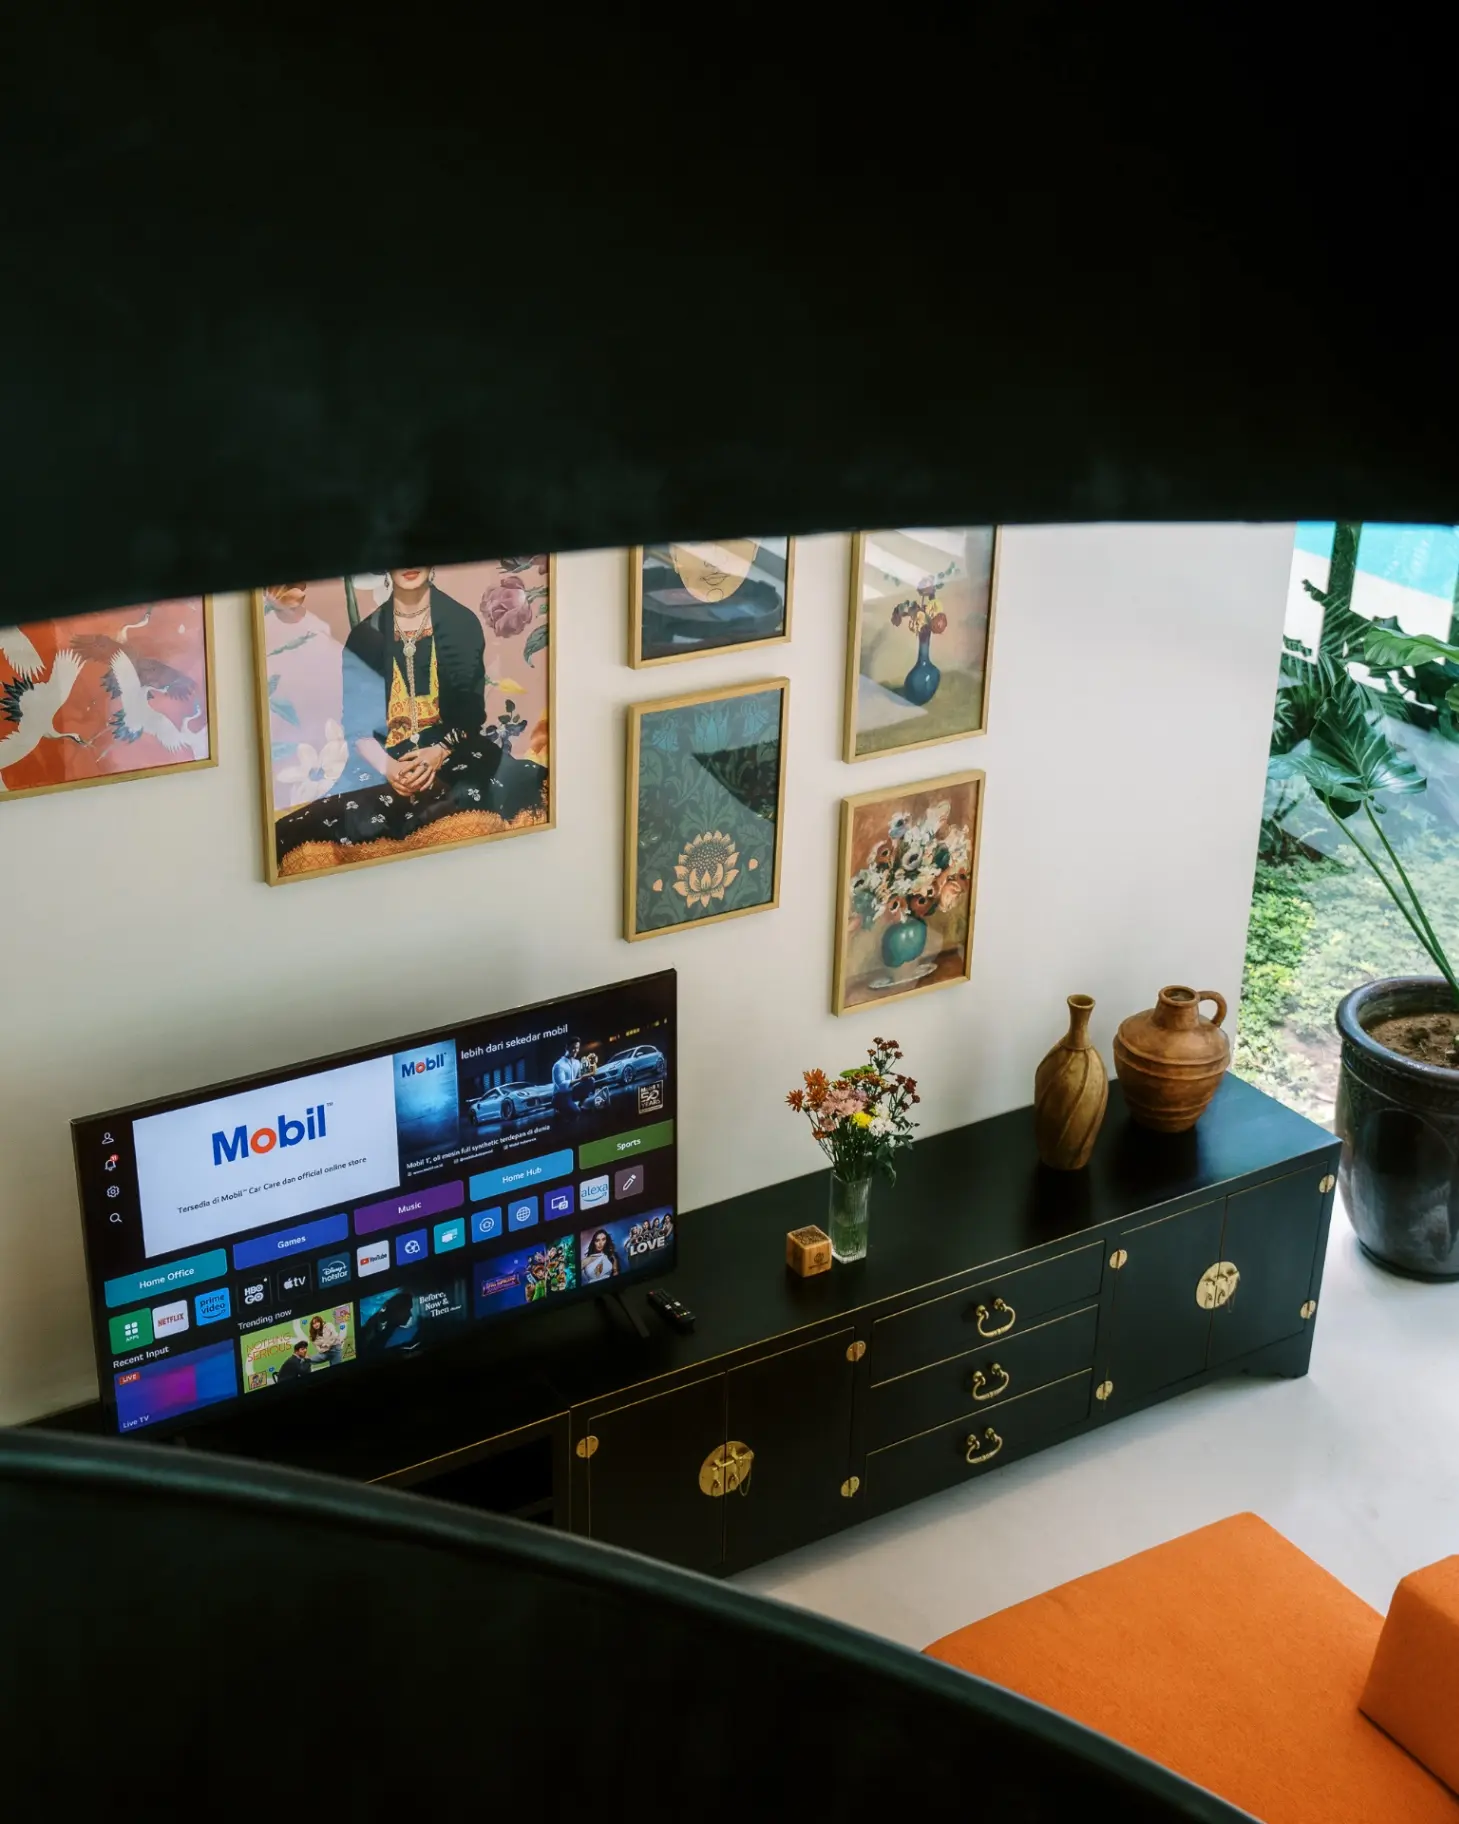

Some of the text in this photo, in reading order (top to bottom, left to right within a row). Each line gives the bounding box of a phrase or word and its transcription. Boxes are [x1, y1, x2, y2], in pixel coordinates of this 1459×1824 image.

[461, 1024, 568, 1060] lebih dari sekedar mobil
[471, 1138, 499, 1152] synthetic
[616, 1138, 642, 1151] Sports
[501, 1167, 542, 1184] Home Hub
[177, 1200, 211, 1214] Tersedia
[212, 1196, 220, 1206] di
[248, 1185, 261, 1195] Car
[263, 1180, 281, 1191] Care
[282, 1175, 296, 1186] dan
[297, 1168, 323, 1182] official
[324, 1163, 347, 1174] online
[348, 1156, 367, 1168] store
[580, 1182, 609, 1198] alexa
[398, 1202, 422, 1214] Music
[277, 1236, 307, 1249] Games
[630, 1235, 665, 1257] LOVE
[369, 1252, 388, 1263] YouTube
[139, 1268, 195, 1289] Home Office
[293, 1275, 306, 1286] tv
[321, 1270, 348, 1284] hotstar
[244, 1283, 264, 1296] HBO
[199, 1293, 225, 1308] prime
[244, 1292, 264, 1305] GO
[419, 1292, 447, 1304] Before,
[200, 1302, 226, 1315] video
[425, 1300, 442, 1311] Now
[430, 1307, 450, 1318] Then
[157, 1312, 184, 1328] NETFLIX
[237, 1309, 293, 1330] Trending now
[125, 1334, 140, 1343] APPS
[246, 1332, 292, 1353] NOTHING
[112, 1346, 170, 1369] Recent Input
[247, 1340, 293, 1362] SERIOUS
[122, 1373, 137, 1383] LIVE
[122, 1414, 150, 1429] Live TV
